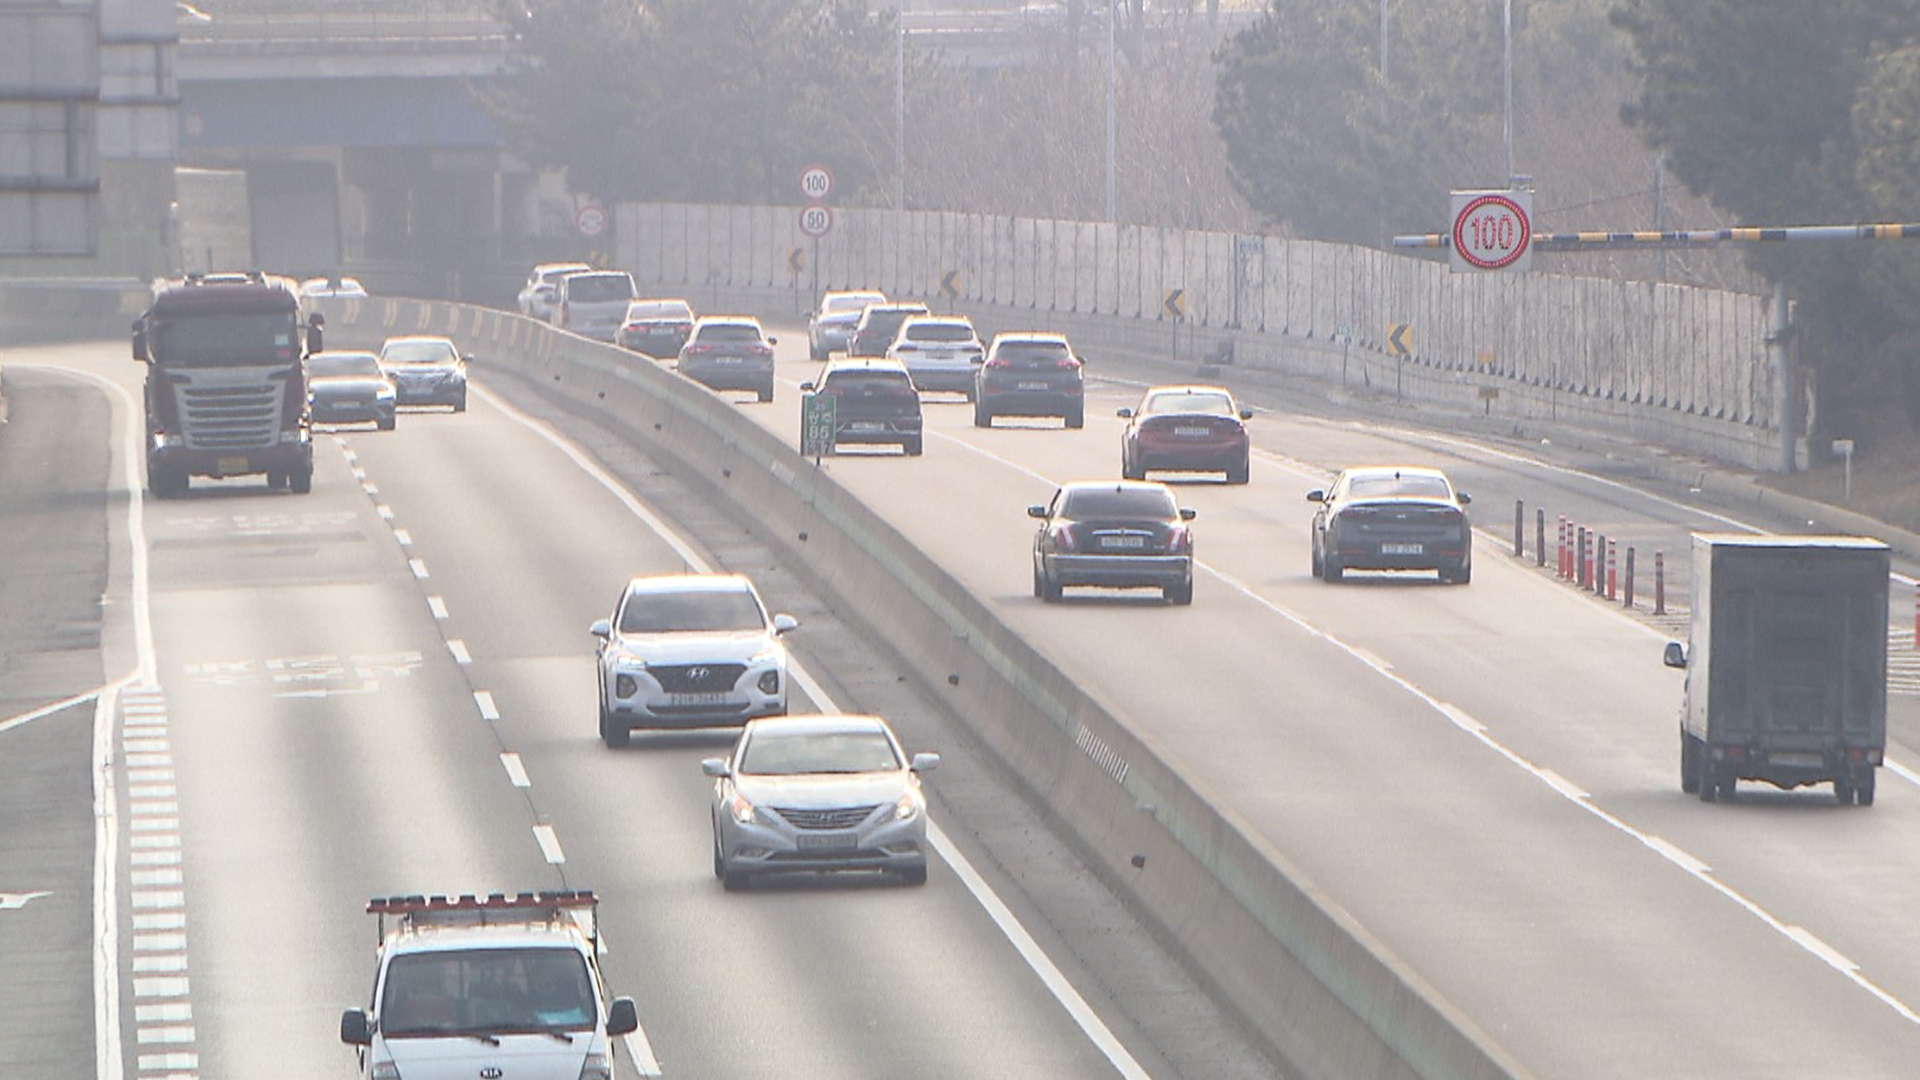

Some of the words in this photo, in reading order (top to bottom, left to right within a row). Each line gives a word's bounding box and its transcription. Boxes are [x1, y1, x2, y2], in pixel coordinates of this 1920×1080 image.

[806, 175, 826, 191] 100
[807, 211, 825, 226] 50
[1471, 213, 1513, 250] 100
[482, 1068, 502, 1079] KIA
